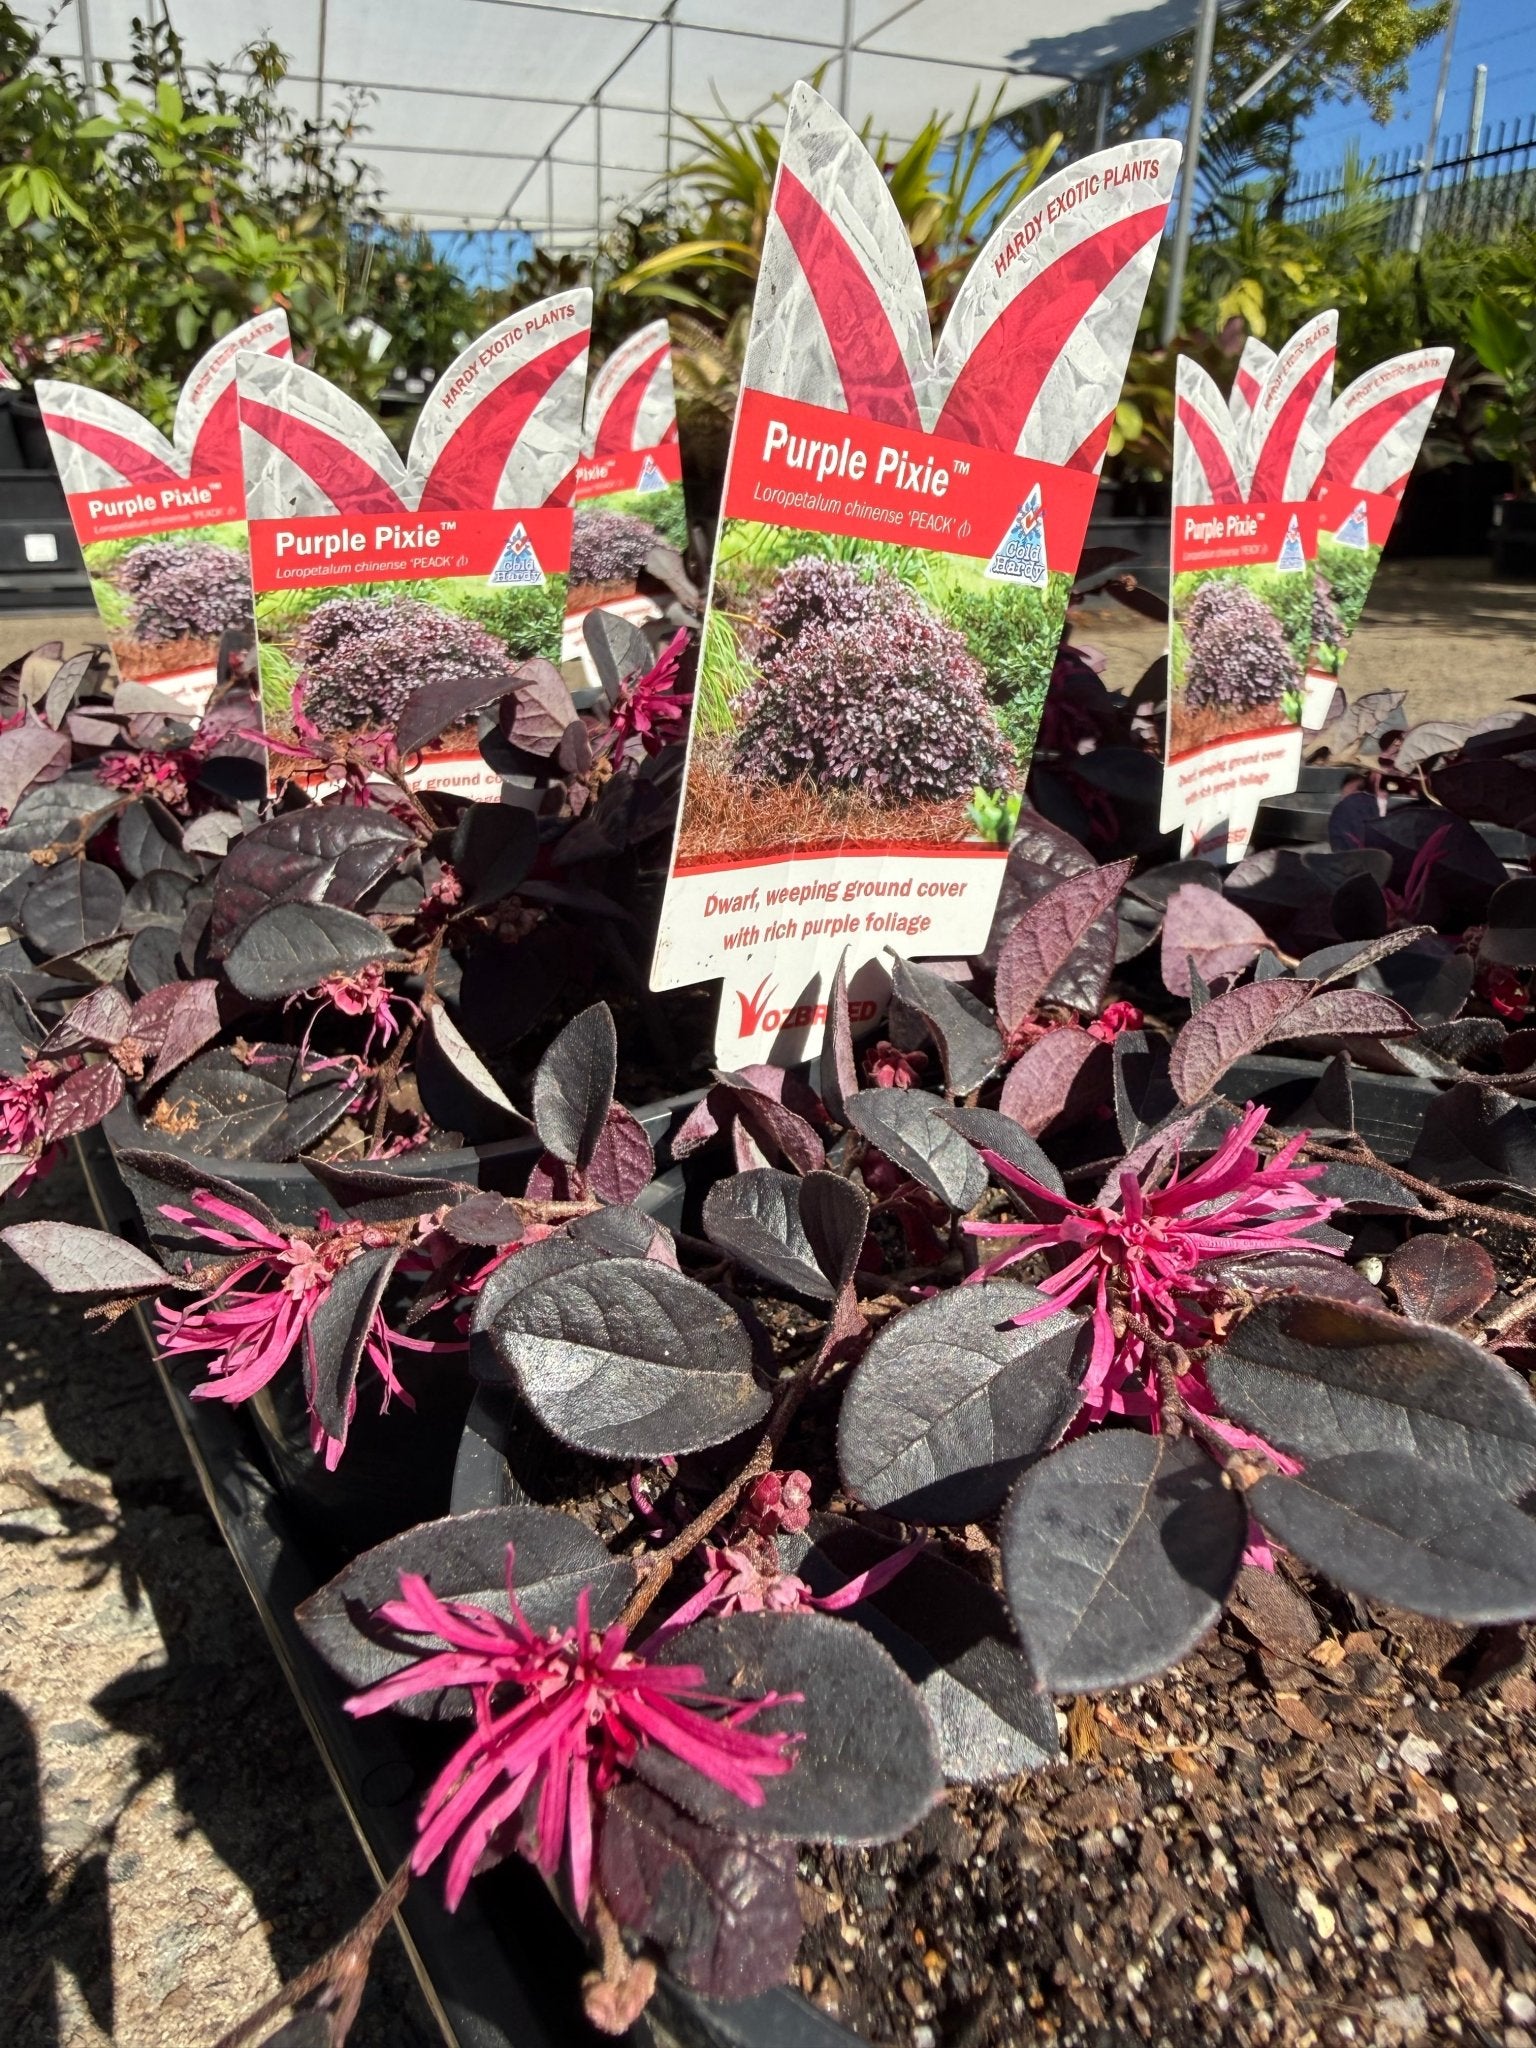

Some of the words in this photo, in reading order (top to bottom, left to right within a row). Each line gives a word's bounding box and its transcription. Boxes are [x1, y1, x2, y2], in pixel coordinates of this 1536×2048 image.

[994, 211, 1043, 278] HARDY
[1046, 174, 1099, 224] EXOTIC
[1103, 159, 1159, 190] PLANTS
[441, 361, 479, 409] HARDY
[479, 327, 523, 367] EXOTIC
[525, 304, 576, 334] PLANTS
[763, 420, 868, 482] Purple
[87, 494, 157, 519] Purple
[753, 481, 842, 514] Loropetalum
[844, 500, 904, 525] chinense
[275, 528, 366, 559] Purple
[1006, 540, 1041, 563] Cold
[275, 564, 351, 579] Loropetalum
[354, 560, 407, 573] chinense
[992, 554, 1045, 582] Hardy
[427, 774, 481, 791] ground
[704, 887, 760, 917] Dwarf,
[766, 880, 841, 906] weeping
[842, 878, 913, 901] ground
[917, 881, 968, 897] cover
[723, 921, 759, 950] with
[763, 918, 797, 942] rich
[802, 914, 860, 940] purple
[865, 912, 931, 935] foliage
